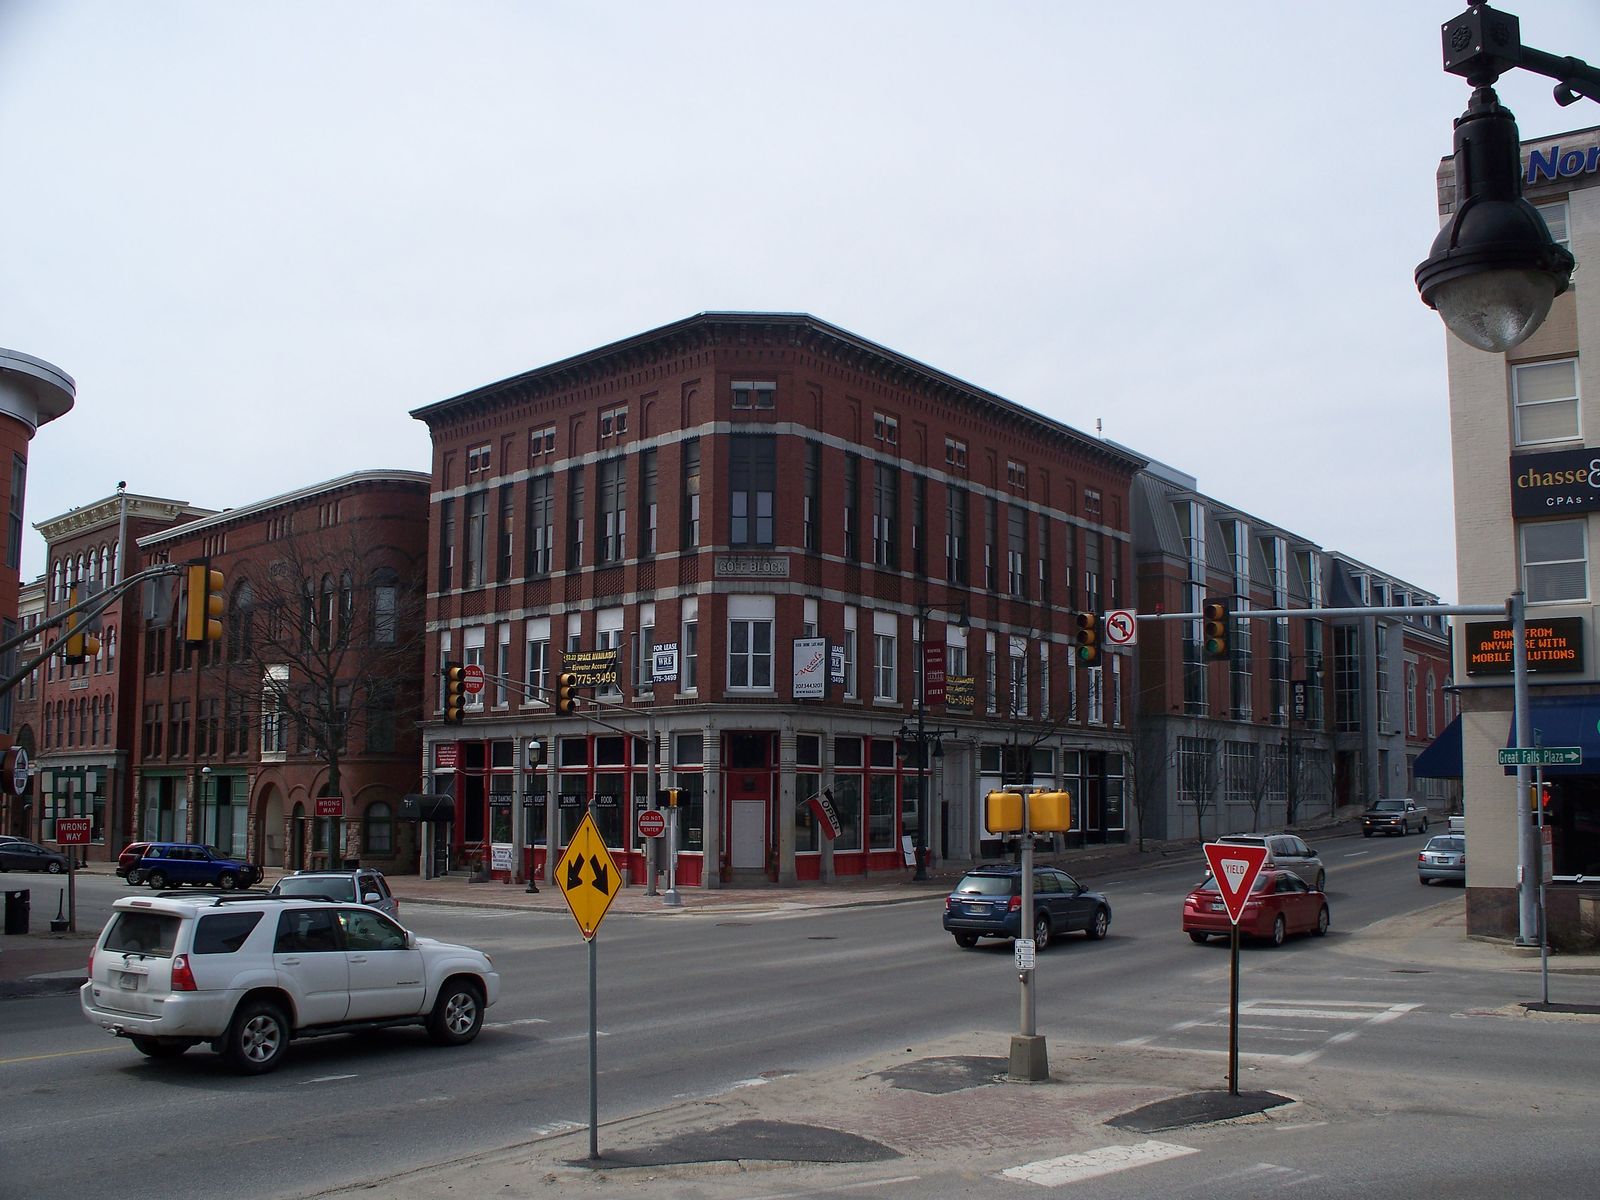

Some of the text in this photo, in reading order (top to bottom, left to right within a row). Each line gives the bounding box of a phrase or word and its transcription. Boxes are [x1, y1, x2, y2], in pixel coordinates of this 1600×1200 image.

[750, 562, 784, 572] BLOCK
[1493, 630, 1516, 640] BAN
[663, 643, 678, 651] LEASE
[1481, 638, 1567, 651] ANYWHRE WITH
[1472, 649, 1575, 663] MOBILE LUTIONS
[577, 671, 617, 685] 775-3499
[1499, 750, 1565, 764] Great Falls Plaza
[600, 796, 613, 804] FOOD
[821, 800, 840, 830] OPEN
[60, 822, 88, 831] WRONG
[65, 832, 82, 841] WAY
[1225, 864, 1246, 875] YIELD
